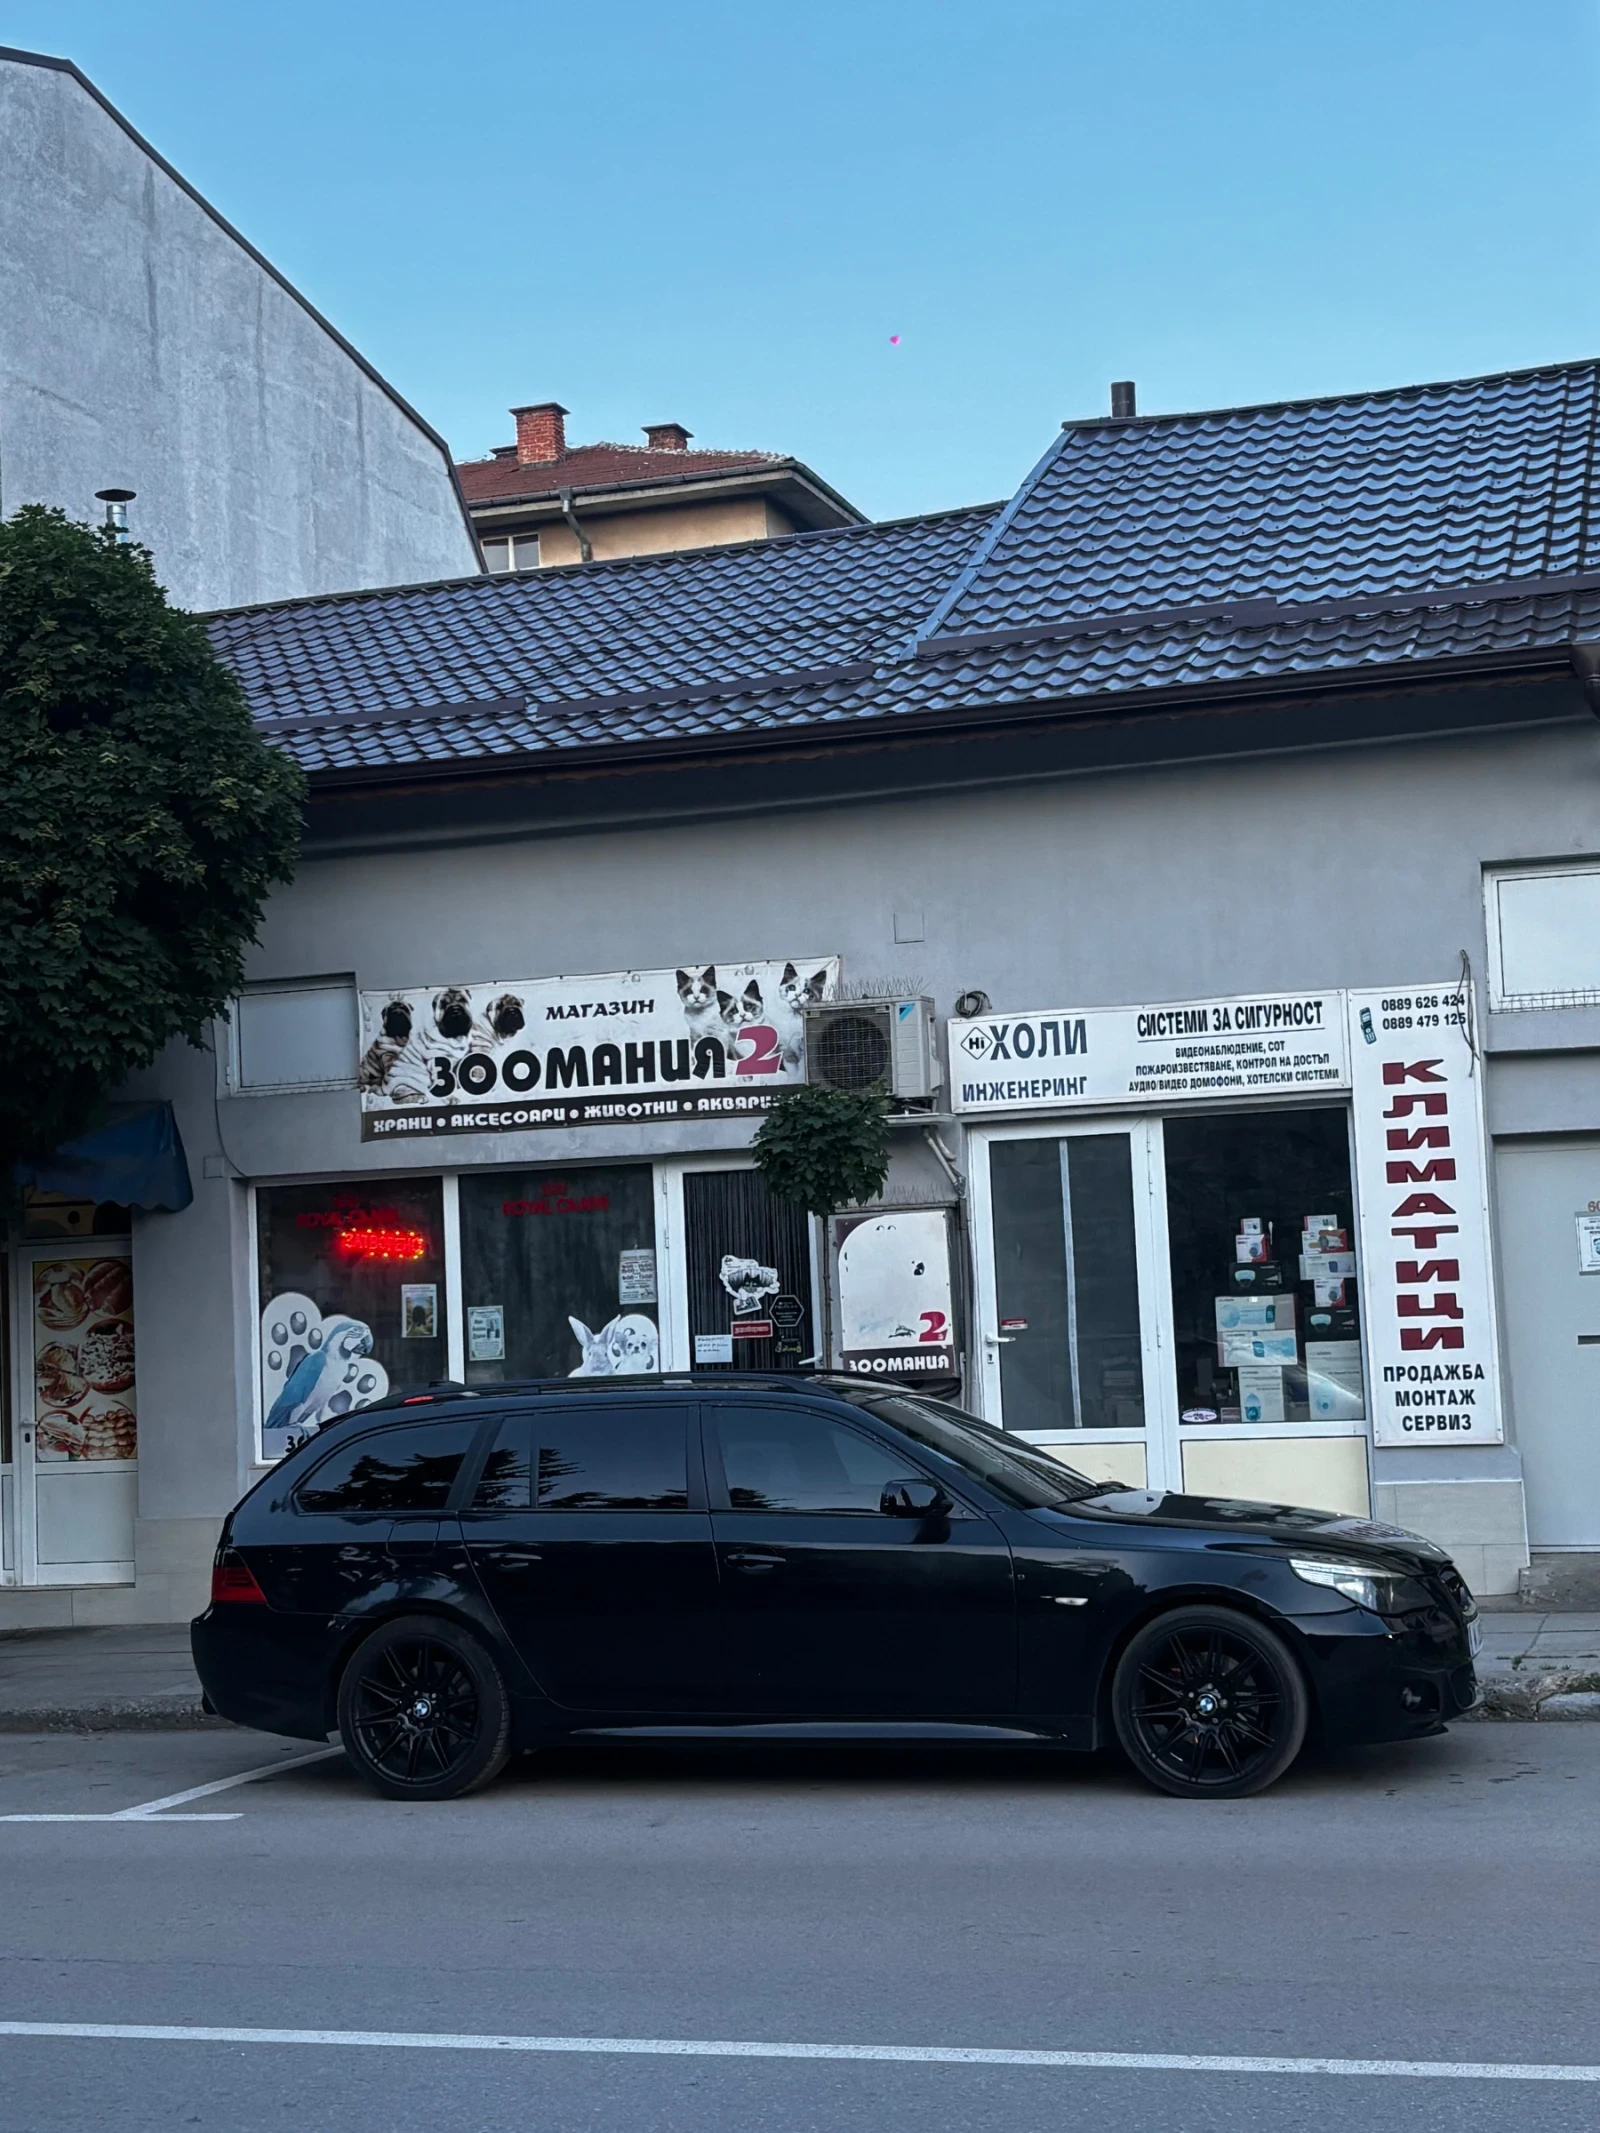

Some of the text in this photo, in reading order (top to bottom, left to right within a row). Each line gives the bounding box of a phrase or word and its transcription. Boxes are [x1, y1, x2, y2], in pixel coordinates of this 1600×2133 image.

[546, 998, 655, 1021] МАГАЗИН
[1381, 993, 1466, 1012] 0889 626 424
[1137, 1001, 1323, 1037] СИСТЕМИ ЗА СИГУРНОСТ
[1382, 1012, 1467, 1030] 0889 479 125
[989, 1019, 1088, 1061] ХОЛИ
[1175, 1041, 1285, 1058] ВИДЕОНАБЛЮДЕНИЕ, СОТ
[430, 1024, 784, 1098] ЗООМАНИЯ 2
[1136, 1053, 1330, 1076] ПОЖАРОИЗВЕСТЯВАНЕ, КОНТРОЛ НА ДОСТЪП
[962, 1076, 1088, 1103] ИНЖЕНЕРИНГ
[1189, 1074, 1245, 1091] ДОМОФОНИ,
[1247, 1072, 1293, 1085] ХОТЕЛСКИ
[1295, 1068, 1339, 1081] СИСТЕМИ
[373, 1116, 433, 1133] ХРАНИ
[451, 1108, 566, 1127] АКСЕСОАРИ
[584, 1100, 678, 1119] ЖИВОТНИ
[1383, 1059, 1465, 1351] КЛИМАТИЦИ
[918, 1310, 948, 1342] 2
[849, 1354, 949, 1373] ЗООМАНИЯ
[1383, 1364, 1485, 1385] ПРОДАЖБА
[1395, 1389, 1476, 1408] МОНТАЖ
[1402, 1413, 1472, 1433] СЕРВИЗ
